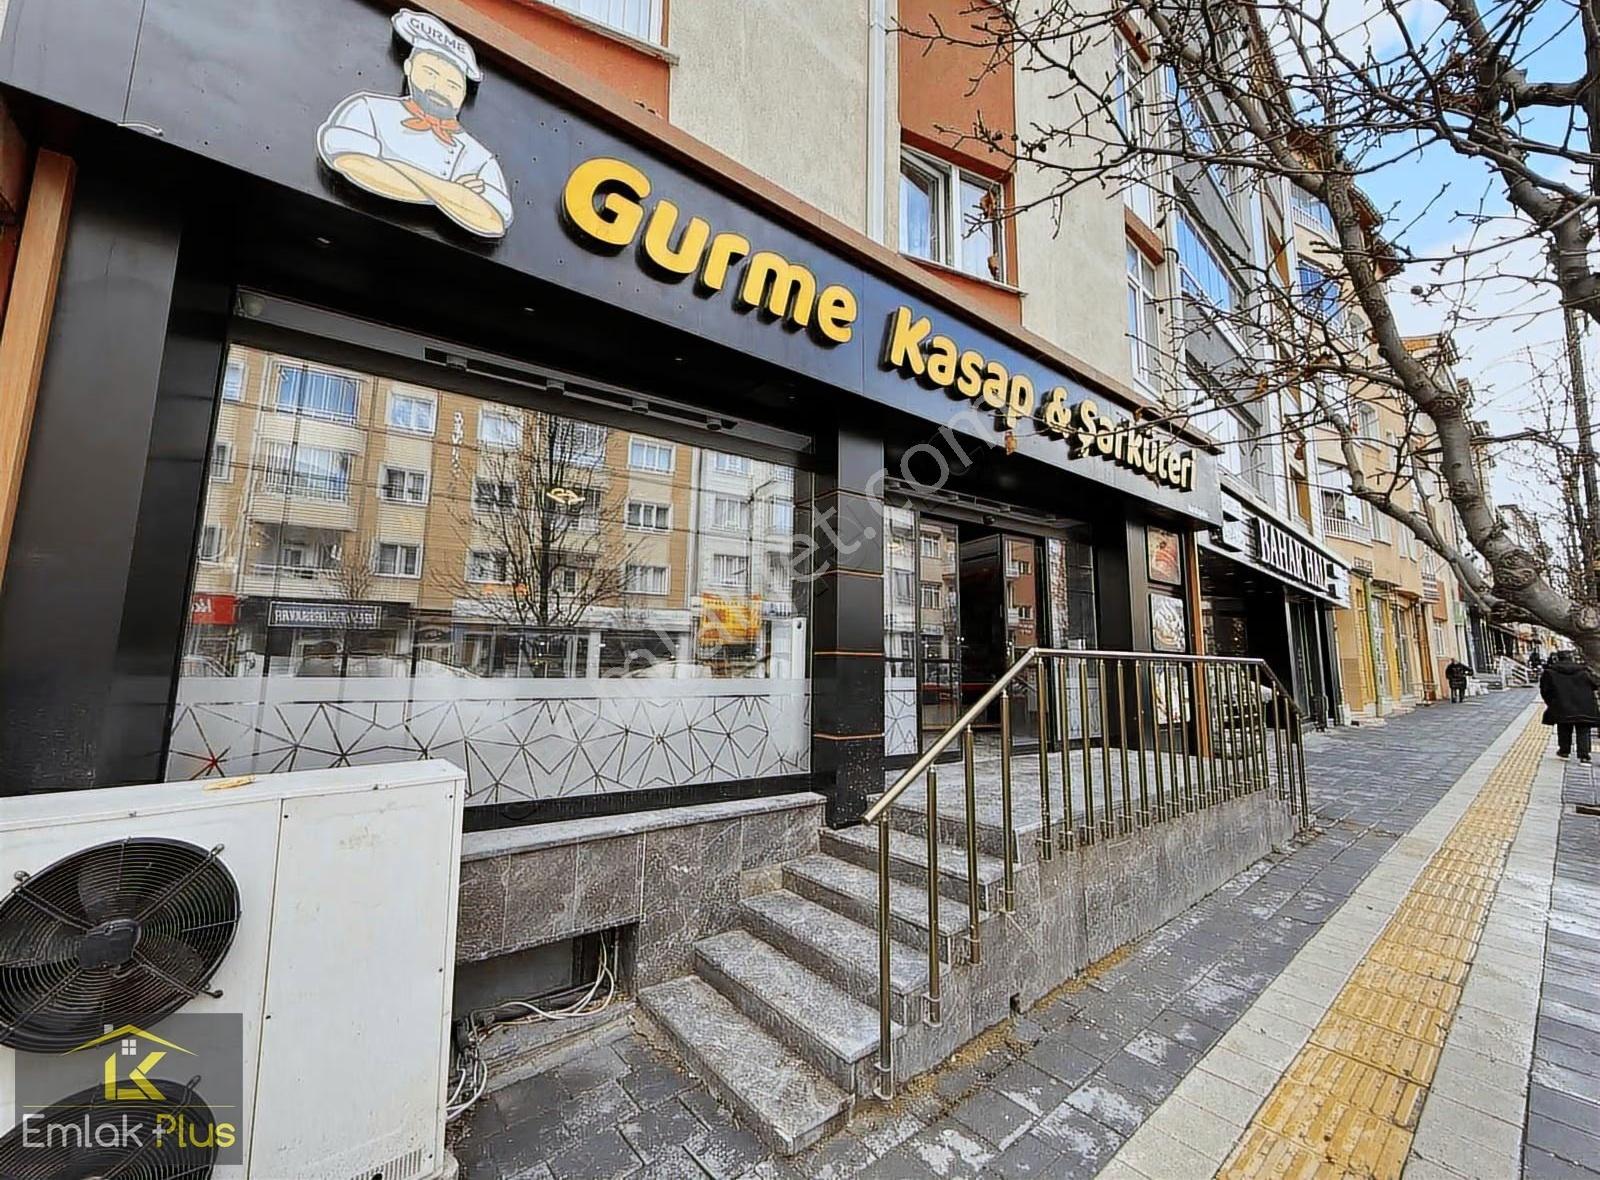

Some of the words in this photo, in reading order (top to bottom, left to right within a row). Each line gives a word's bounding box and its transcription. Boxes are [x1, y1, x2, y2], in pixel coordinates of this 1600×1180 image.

[410, 17, 467, 54] GURME
[563, 156, 859, 344] Gurme
[888, 305, 1036, 428] Kasap
[1044, 387, 1072, 437] &
[1258, 517, 1308, 583] BAHAR
